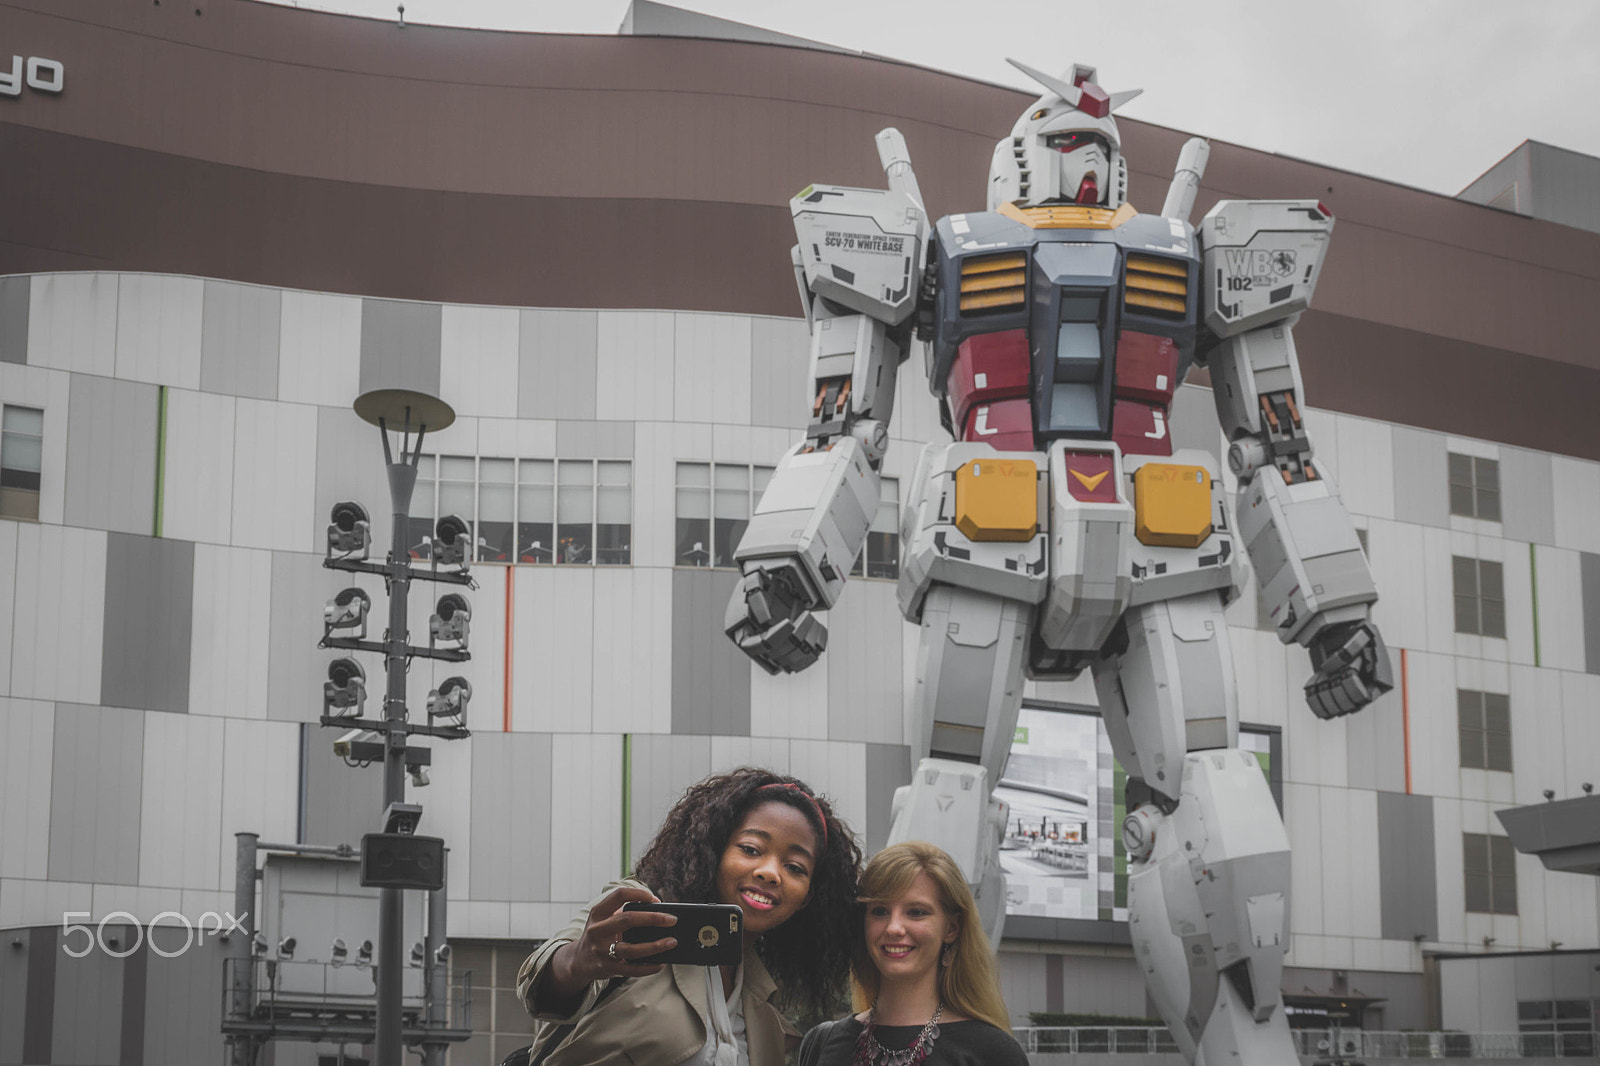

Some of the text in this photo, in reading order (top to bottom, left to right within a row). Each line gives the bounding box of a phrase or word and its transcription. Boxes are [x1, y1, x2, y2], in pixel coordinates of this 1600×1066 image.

[825, 237, 854, 248] SCV-70
[1225, 250, 1272, 277] WB
[1227, 277, 1252, 291] 102
